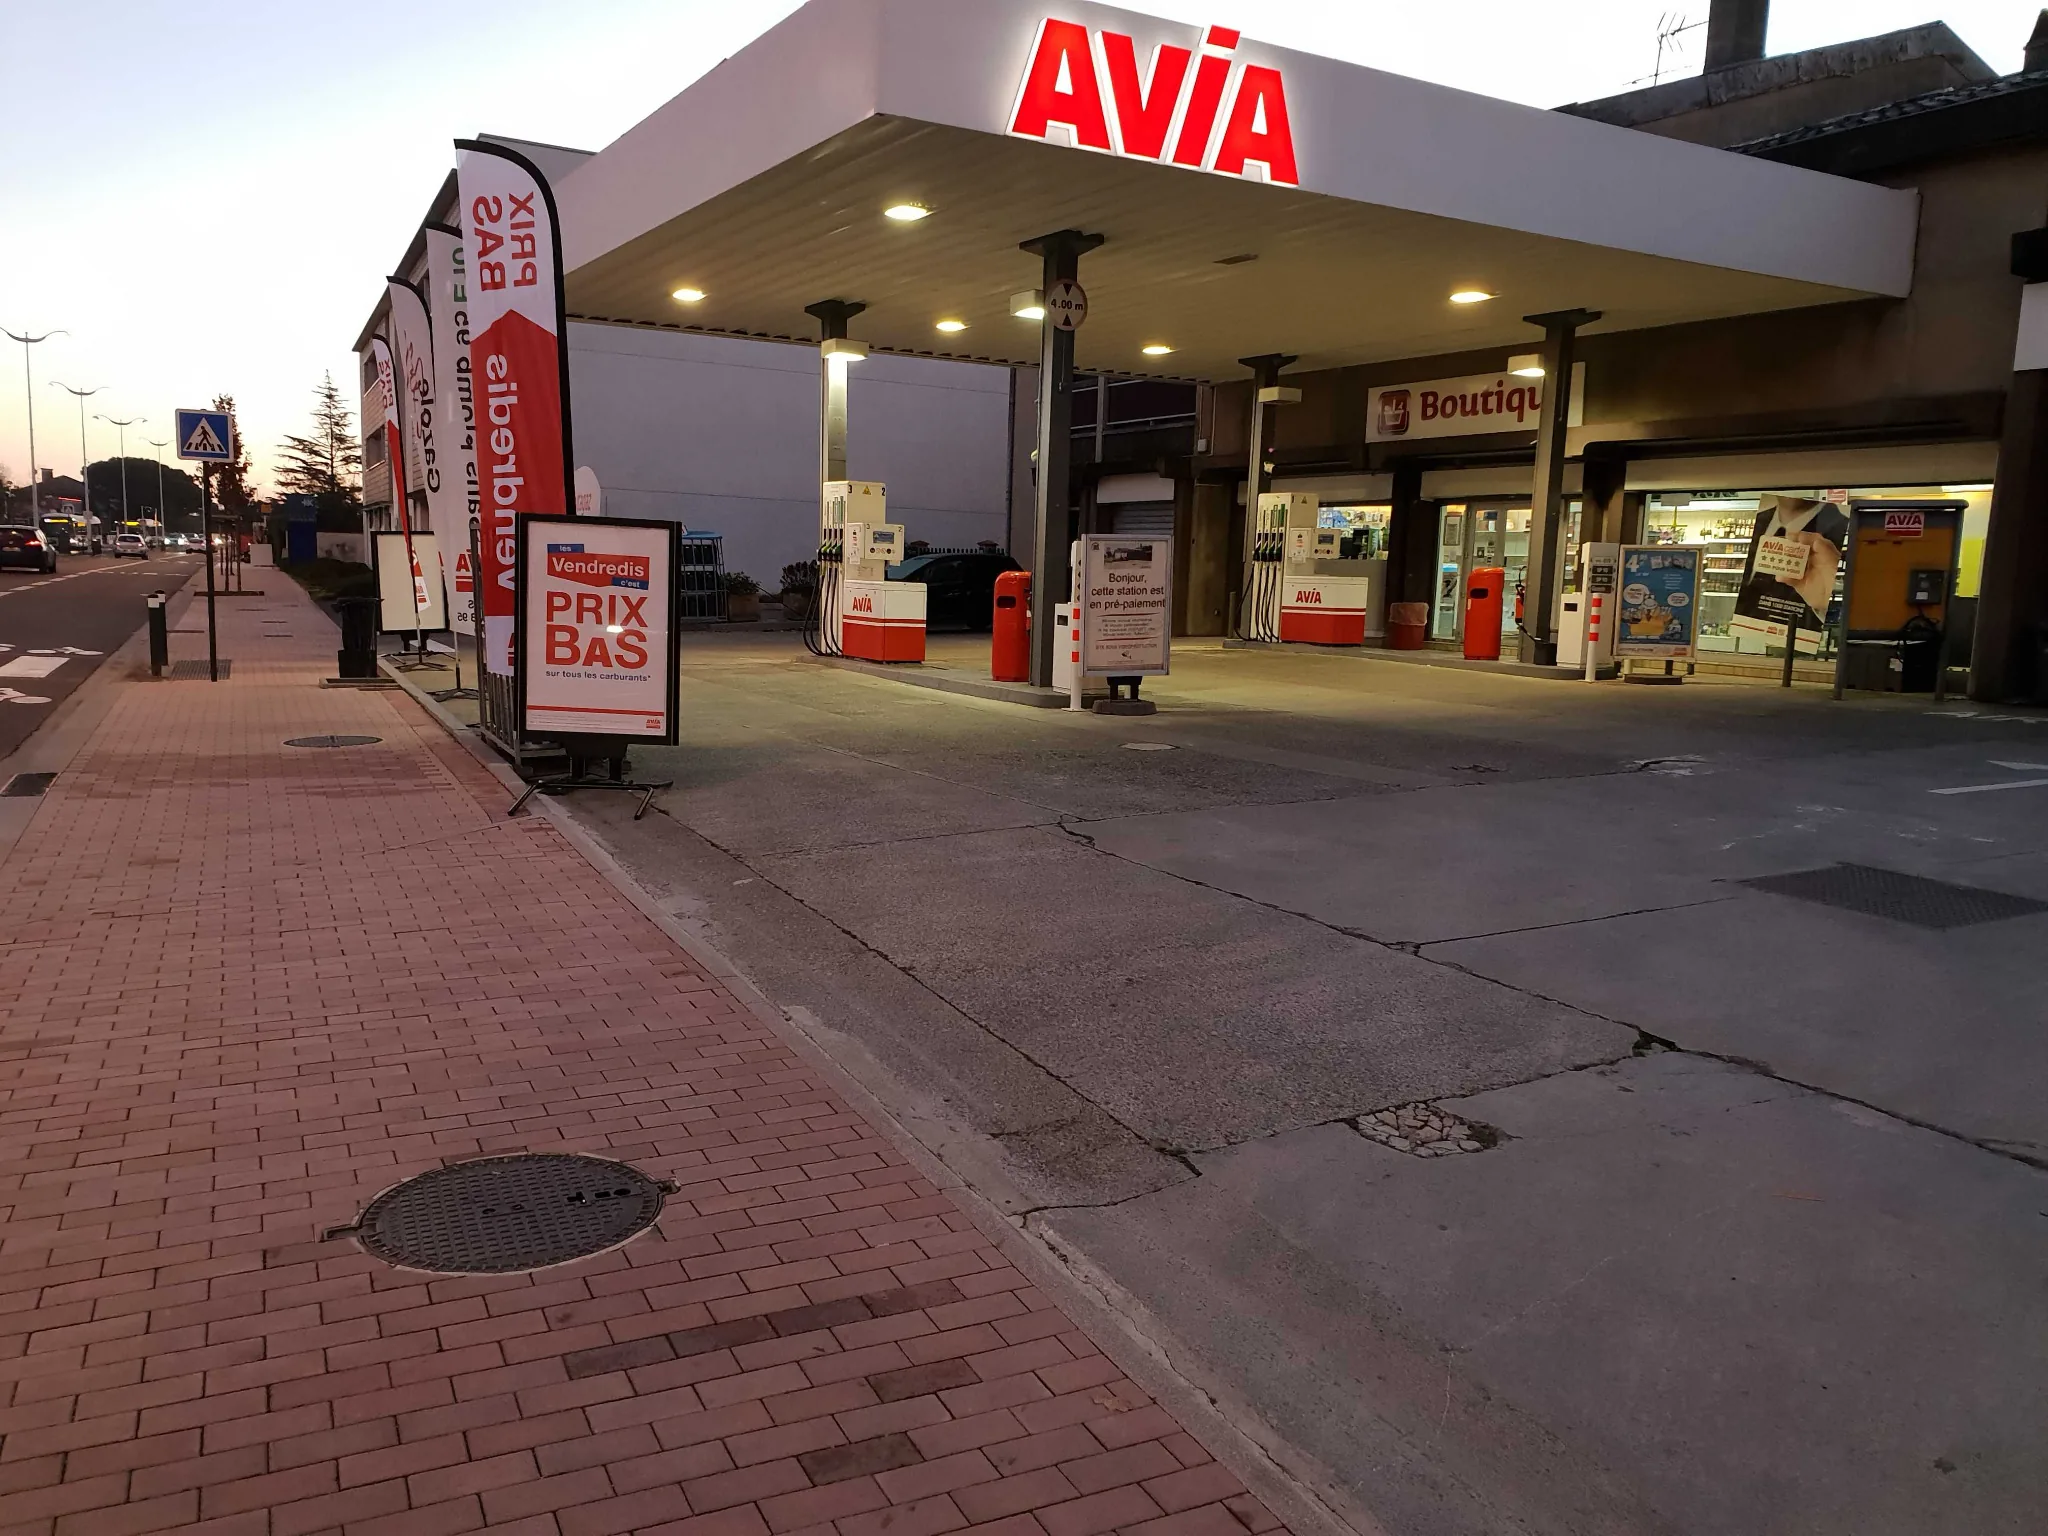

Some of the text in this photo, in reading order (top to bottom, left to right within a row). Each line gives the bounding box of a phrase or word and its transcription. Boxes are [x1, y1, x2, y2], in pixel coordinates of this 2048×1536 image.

[1051, 298, 1073, 310] 4.00
[1419, 379, 1542, 423] Boutiqu
[551, 556, 645, 577] Vendredis
[620, 579, 640, 588] c'est
[1108, 572, 1147, 585] Bonjour,
[1091, 586, 1165, 596] cette station est
[546, 590, 649, 628] PRIX
[1089, 598, 1166, 611] en pré-paiement
[562, 671, 582, 679] tous
[584, 671, 597, 680] les
